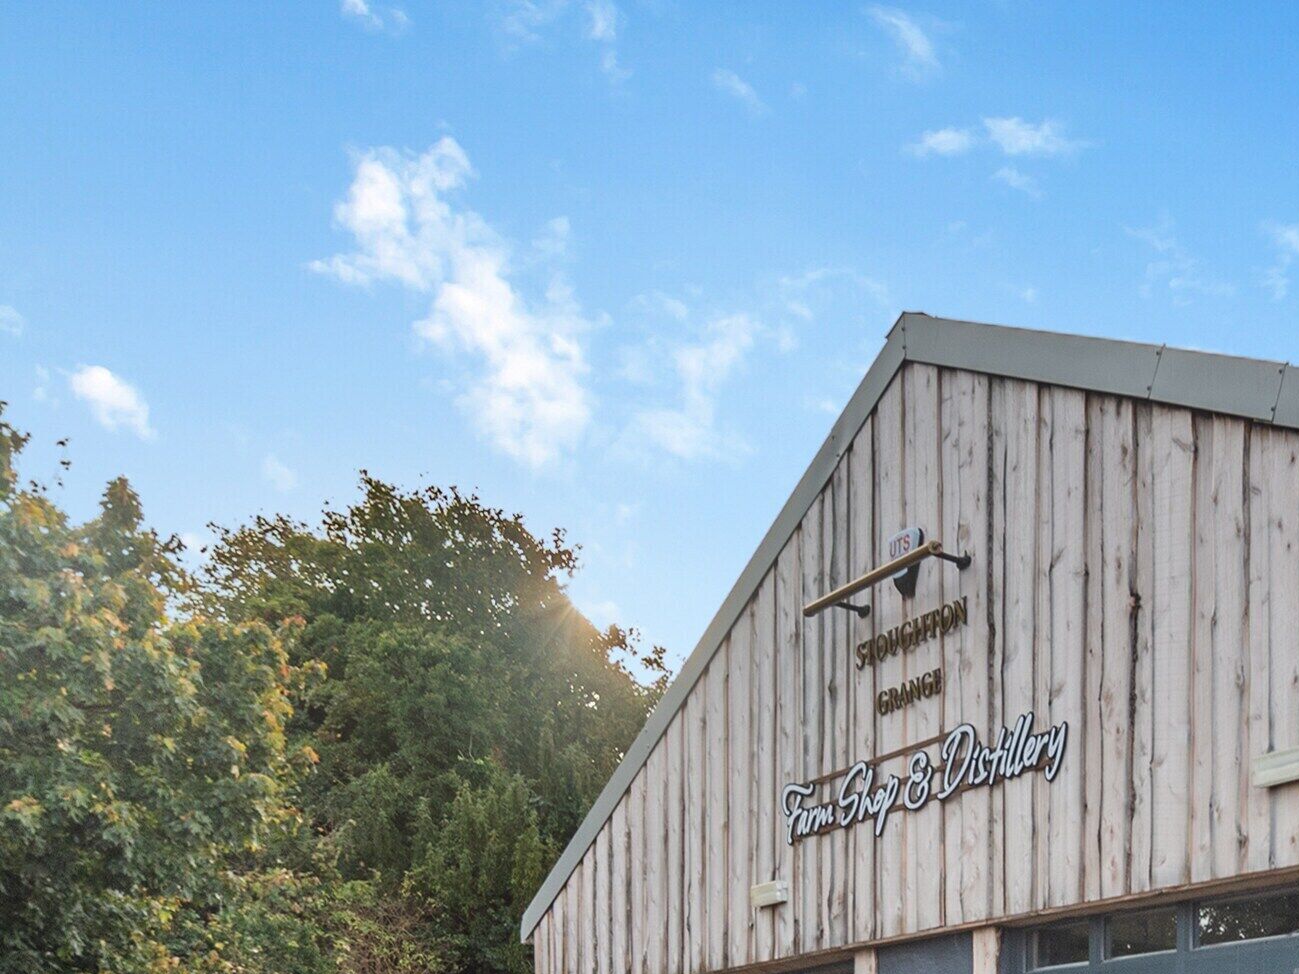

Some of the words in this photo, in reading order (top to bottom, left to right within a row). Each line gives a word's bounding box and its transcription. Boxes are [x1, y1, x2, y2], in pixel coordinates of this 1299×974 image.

[855, 596, 968, 671] STOUGHTON
[876, 668, 942, 716] GRANGE
[782, 782, 834, 845] Farm
[838, 760, 899, 837] Shop
[903, 750, 933, 811] &
[936, 711, 1068, 800] Distillery
